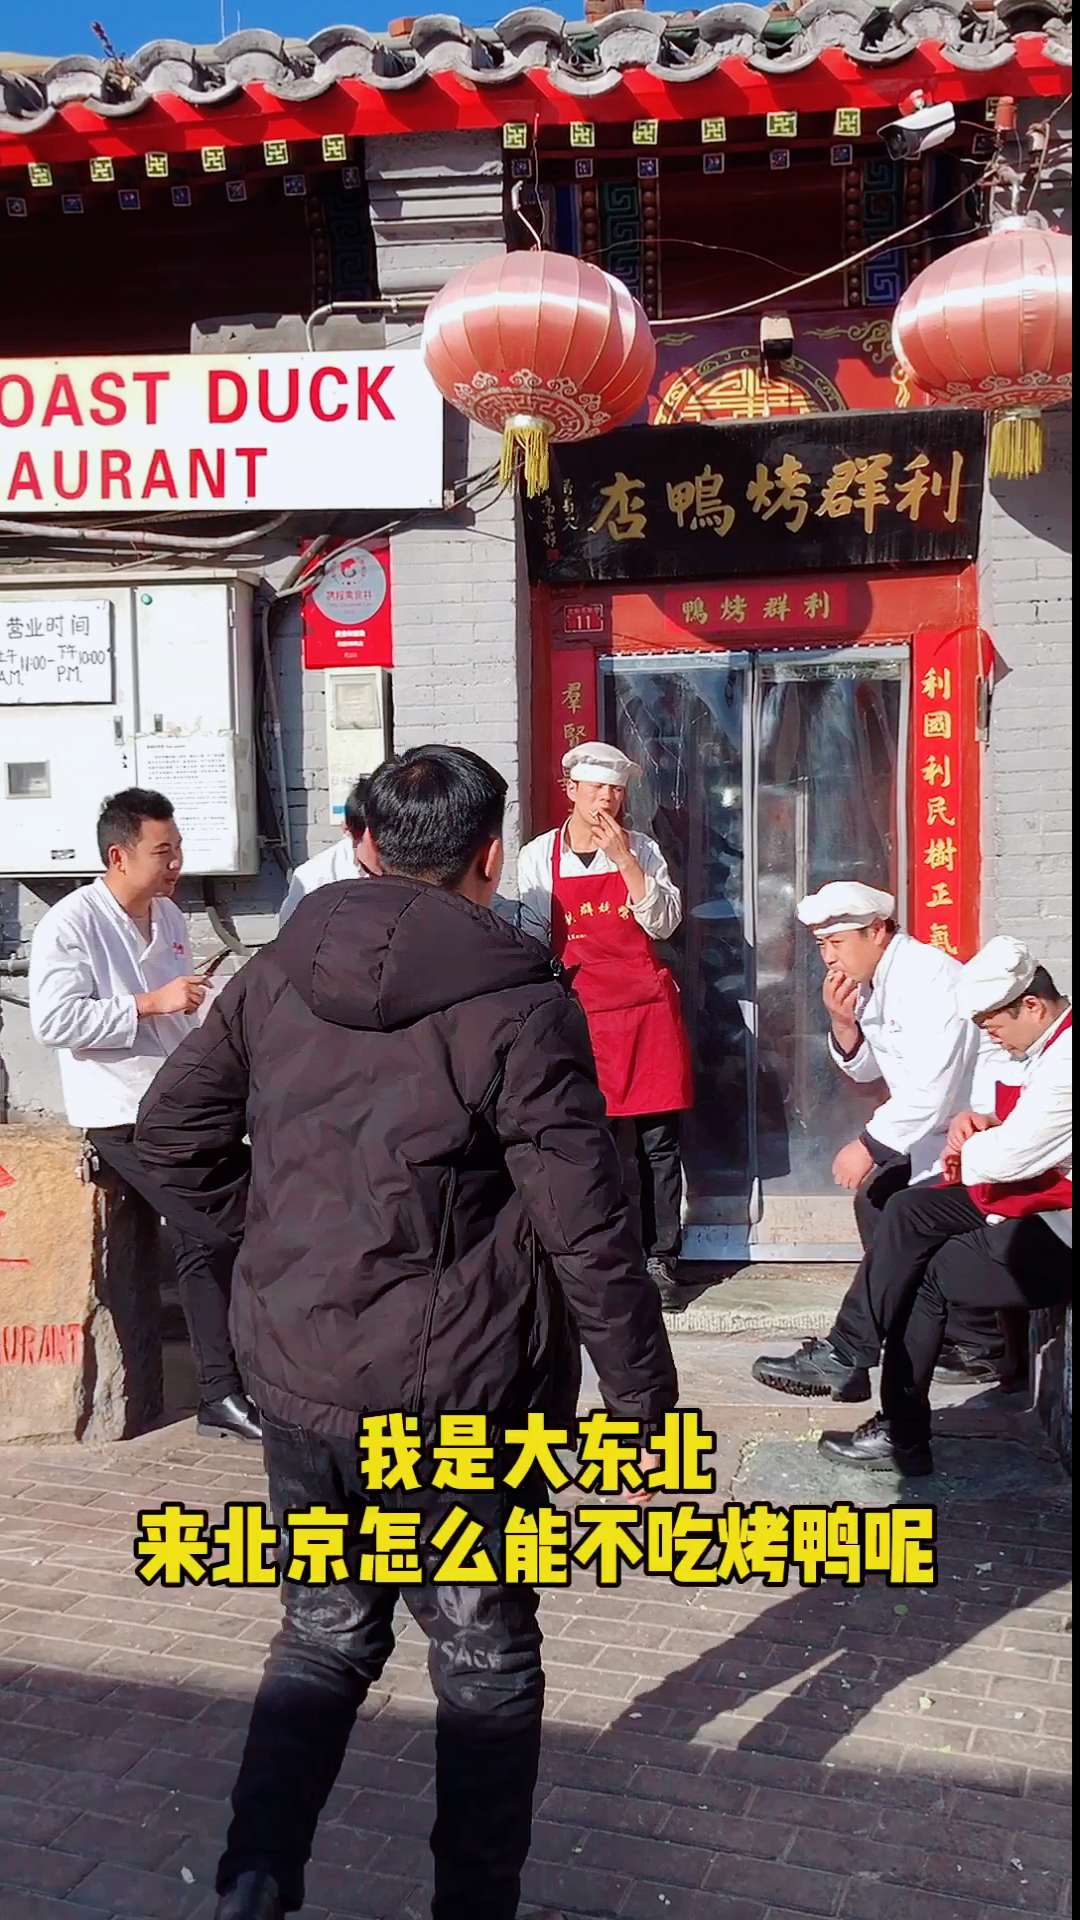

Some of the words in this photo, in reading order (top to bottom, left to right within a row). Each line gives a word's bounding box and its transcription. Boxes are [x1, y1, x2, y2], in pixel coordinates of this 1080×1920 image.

[208, 365, 396, 424] DUCK
[7, 447, 268, 501] AURANT
[587, 450, 964, 541] 利群烤鴨店
[6, 614, 89, 639] 营业时间
[577, 615, 591, 630] 11
[682, 590, 830, 625] 利群烤鴨
[920, 666, 958, 955] 利國利民樹正氣
[0, 1322, 81, 1367] URANT
